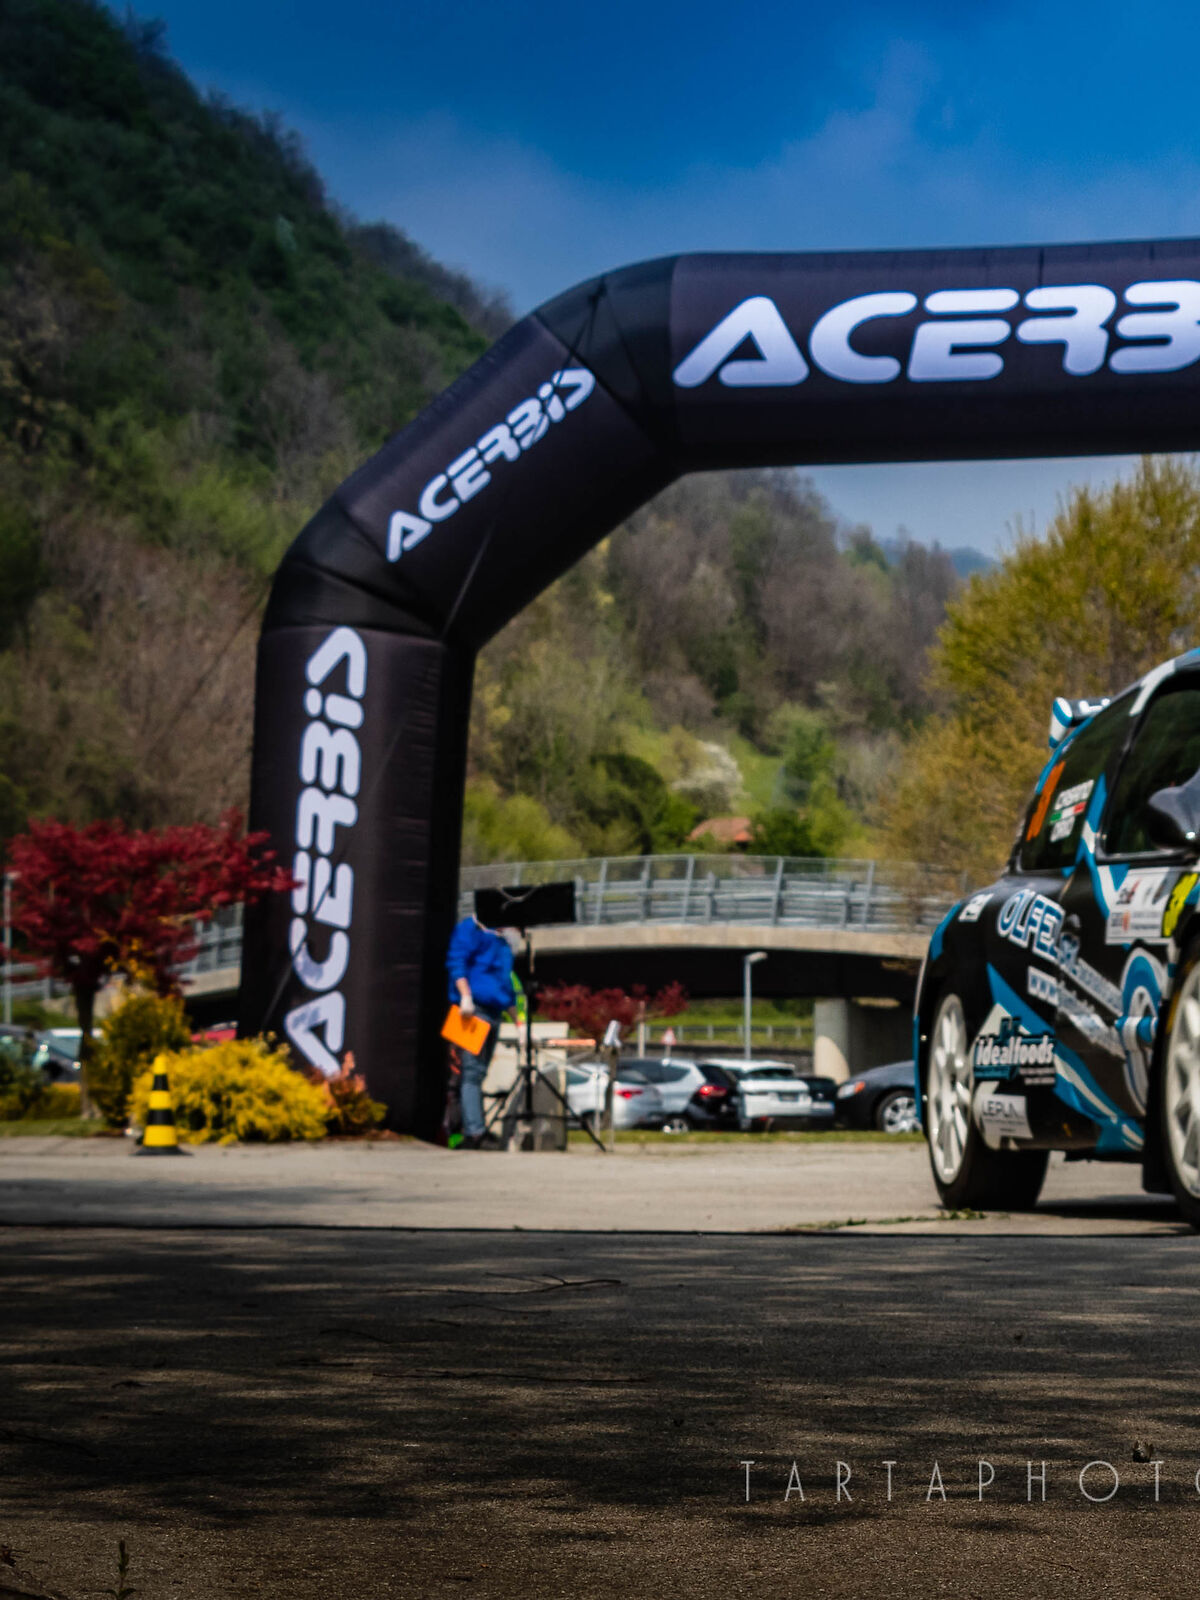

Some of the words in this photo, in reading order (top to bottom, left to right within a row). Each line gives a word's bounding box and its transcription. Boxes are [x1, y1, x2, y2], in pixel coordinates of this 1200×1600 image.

[386, 366, 596, 563] ACERBIS
[284, 625, 368, 1078] ACERBIS
[976, 1034, 1054, 1065] idealfoods
